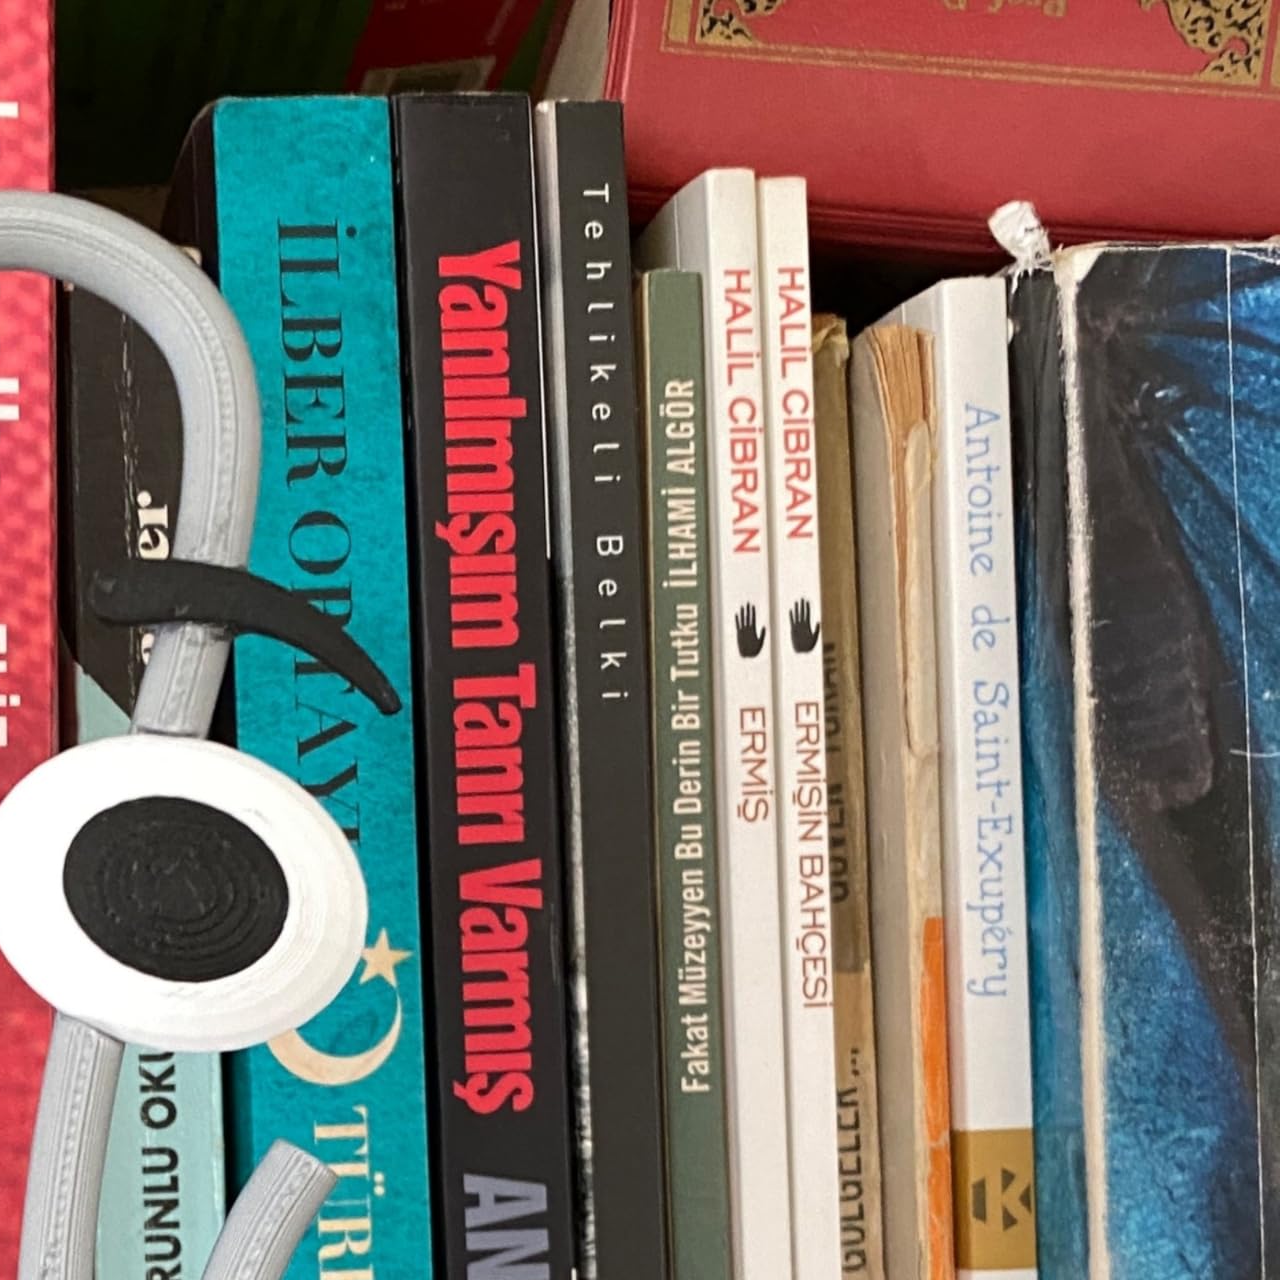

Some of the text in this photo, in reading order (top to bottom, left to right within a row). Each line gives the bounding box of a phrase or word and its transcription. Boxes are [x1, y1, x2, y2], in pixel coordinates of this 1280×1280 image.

[277, 216, 357, 489] İLBER
[581, 184, 631, 701] Tehlikeli Belki
[723, 268, 763, 553] HALİL CİBRAN
[778, 266, 808, 380] HALİL
[660, 378, 712, 1092] Fakat Müzeyyen Bu Derin Bir Tutku İLHAMİ ALGÖR
[737, 706, 773, 823] ERMİŞ
[963, 402, 1016, 998] Antoine de Saint-Exupéry
[796, 854, 834, 1009] BAHÇESİ
